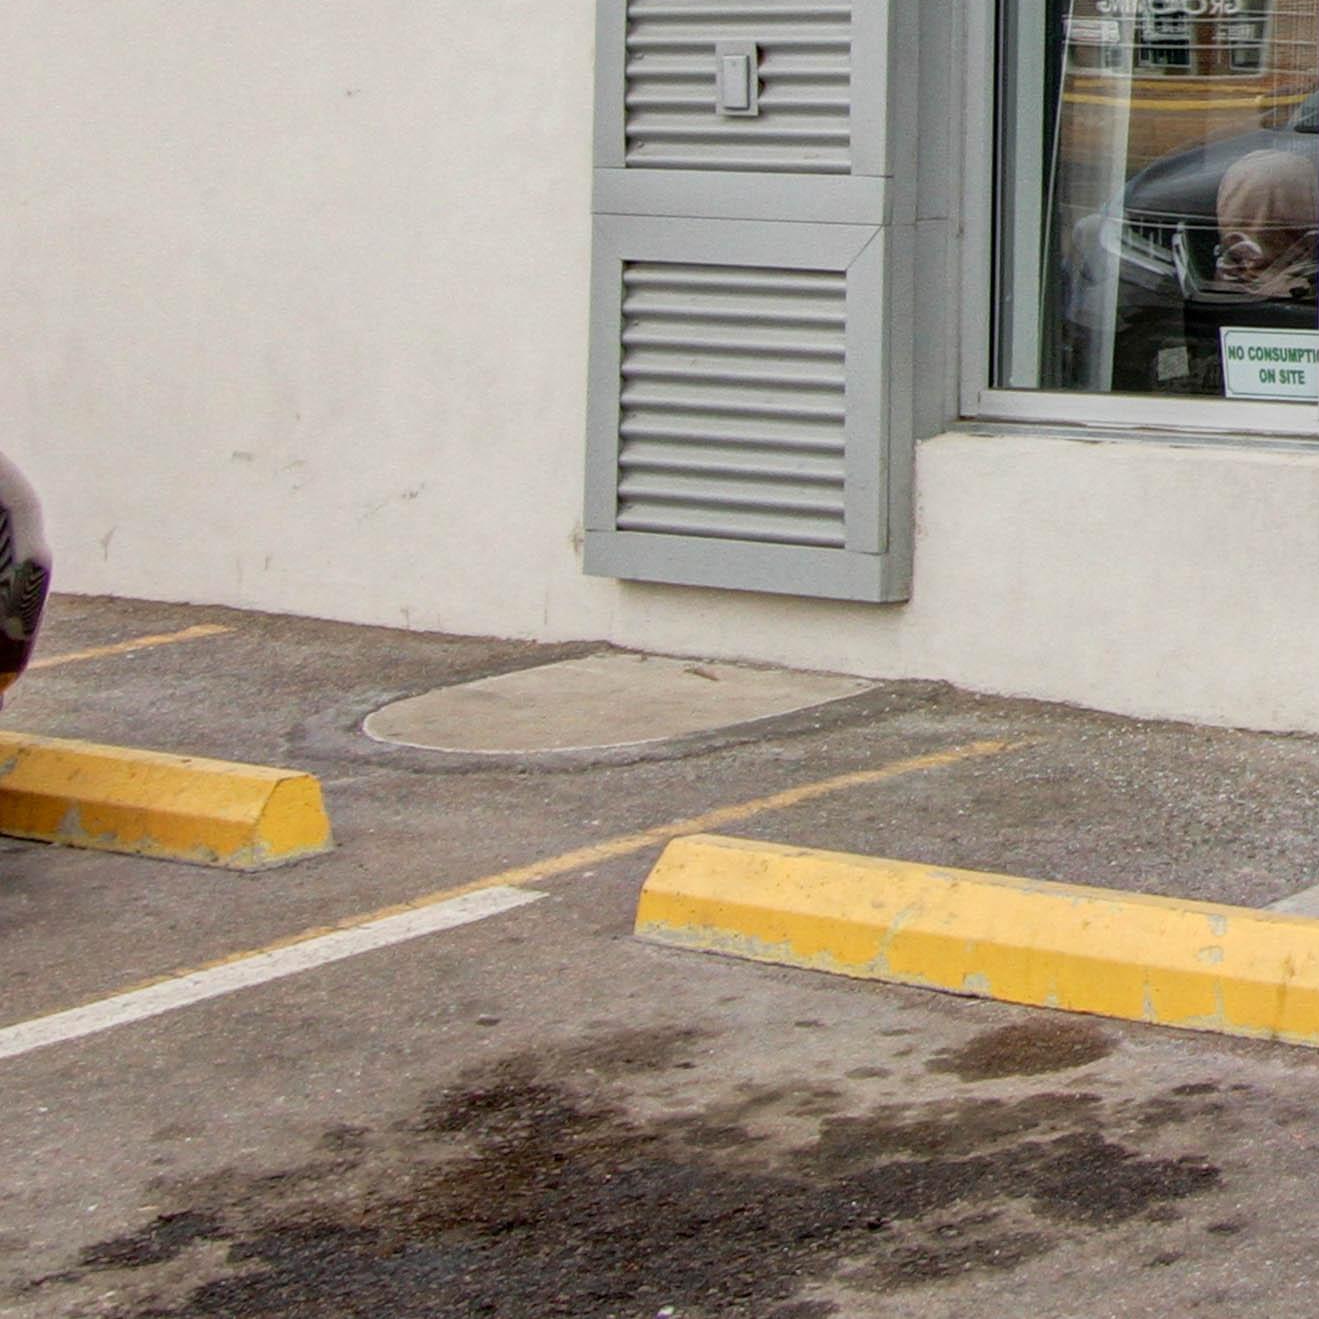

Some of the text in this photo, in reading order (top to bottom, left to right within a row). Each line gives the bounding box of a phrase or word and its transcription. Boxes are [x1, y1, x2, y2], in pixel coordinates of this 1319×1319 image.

[1227, 345, 1245, 360] NO
[1259, 368, 1306, 385] ON SITE
